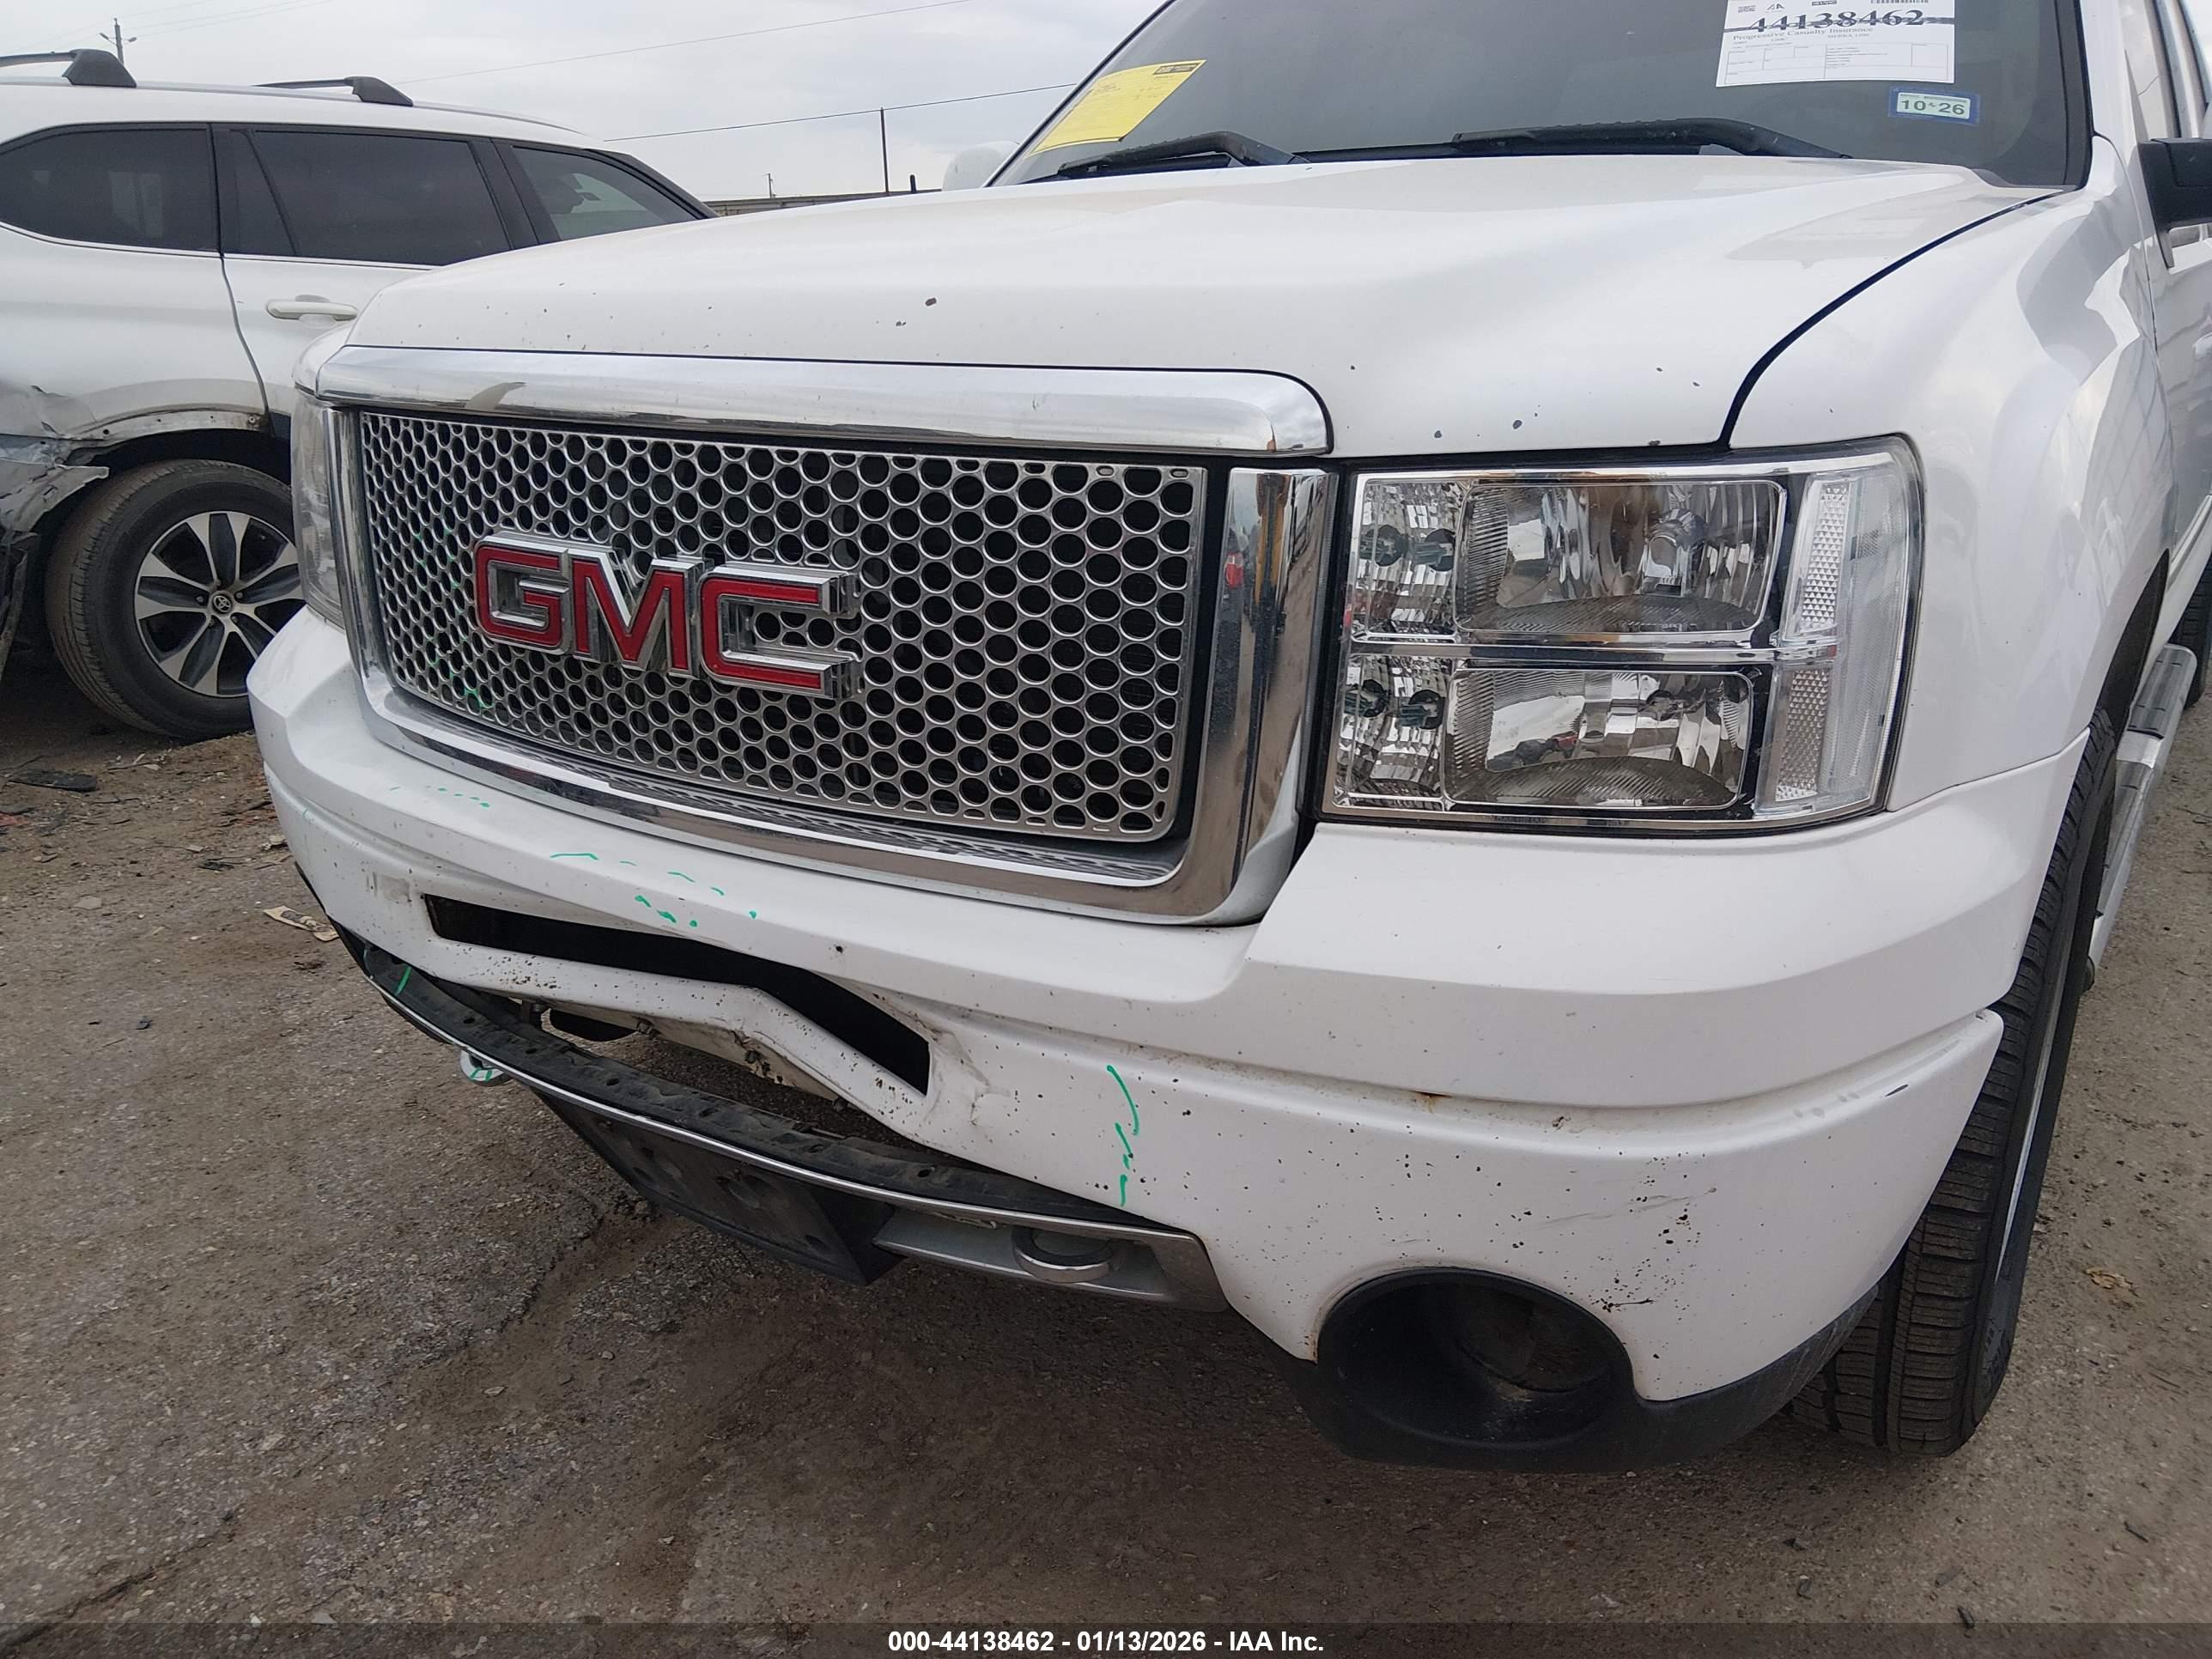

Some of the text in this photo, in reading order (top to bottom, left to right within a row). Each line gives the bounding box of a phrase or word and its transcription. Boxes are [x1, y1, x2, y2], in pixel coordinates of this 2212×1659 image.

[1750, 9, 1924, 33] 44138462
[1733, 32, 1785, 41] Progressive
[1787, 28, 1826, 37] Casualty
[1900, 100, 1966, 115] 10 26
[475, 532, 857, 700] GMC
